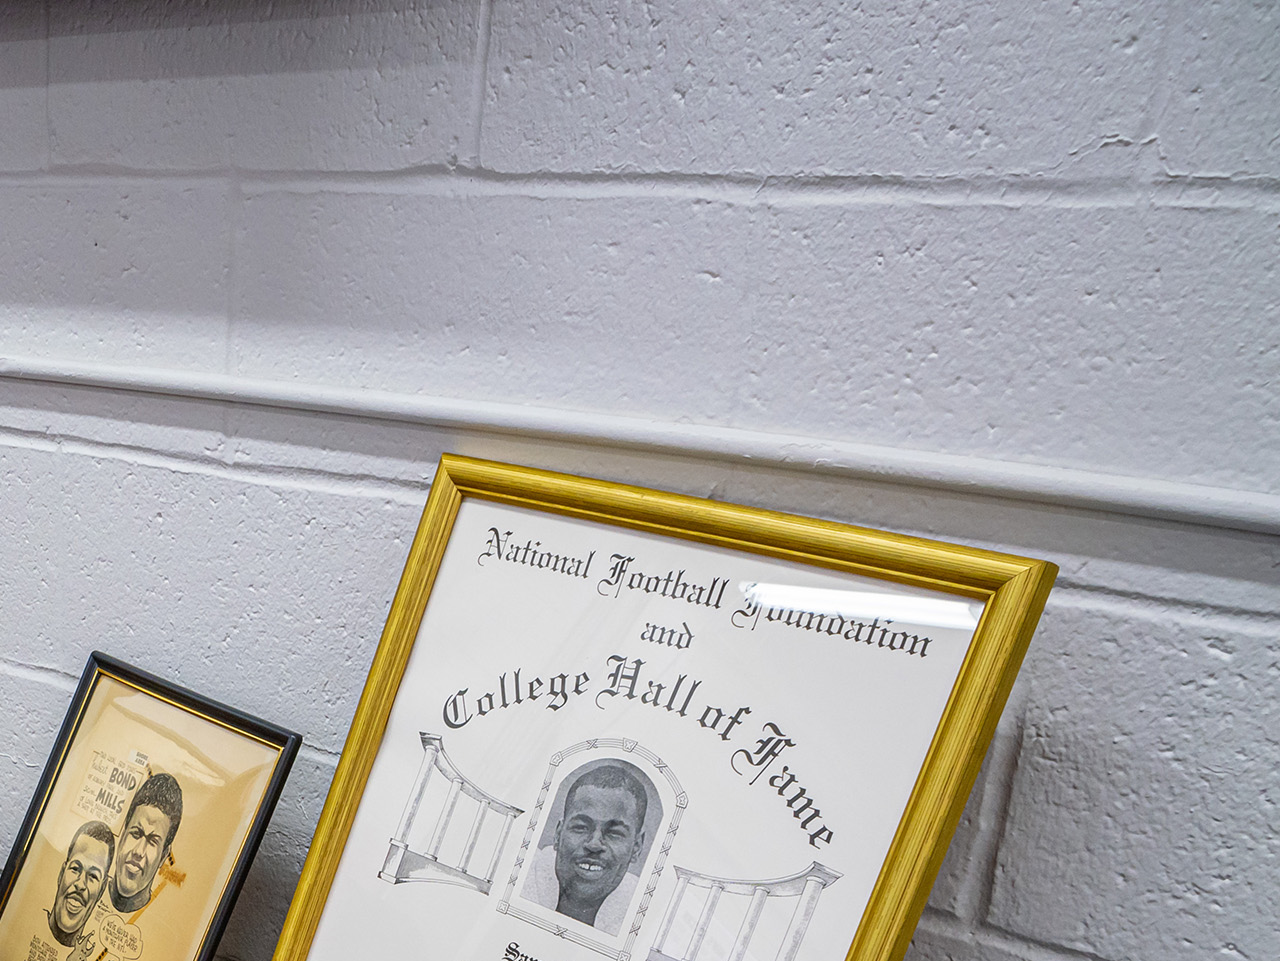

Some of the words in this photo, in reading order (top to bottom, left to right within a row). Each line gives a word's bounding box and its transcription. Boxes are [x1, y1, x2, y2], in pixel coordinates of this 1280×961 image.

[477, 527, 596, 579] National
[596, 553, 730, 609] Football
[731, 583, 933, 657] Foundation
[640, 622, 695, 650] and
[442, 669, 590, 731] College
[595, 655, 703, 719] Hall
[697, 704, 753, 742] of
[731, 721, 835, 850] Fame
[109, 767, 137, 791] BOND
[95, 787, 126, 814] MILLS
